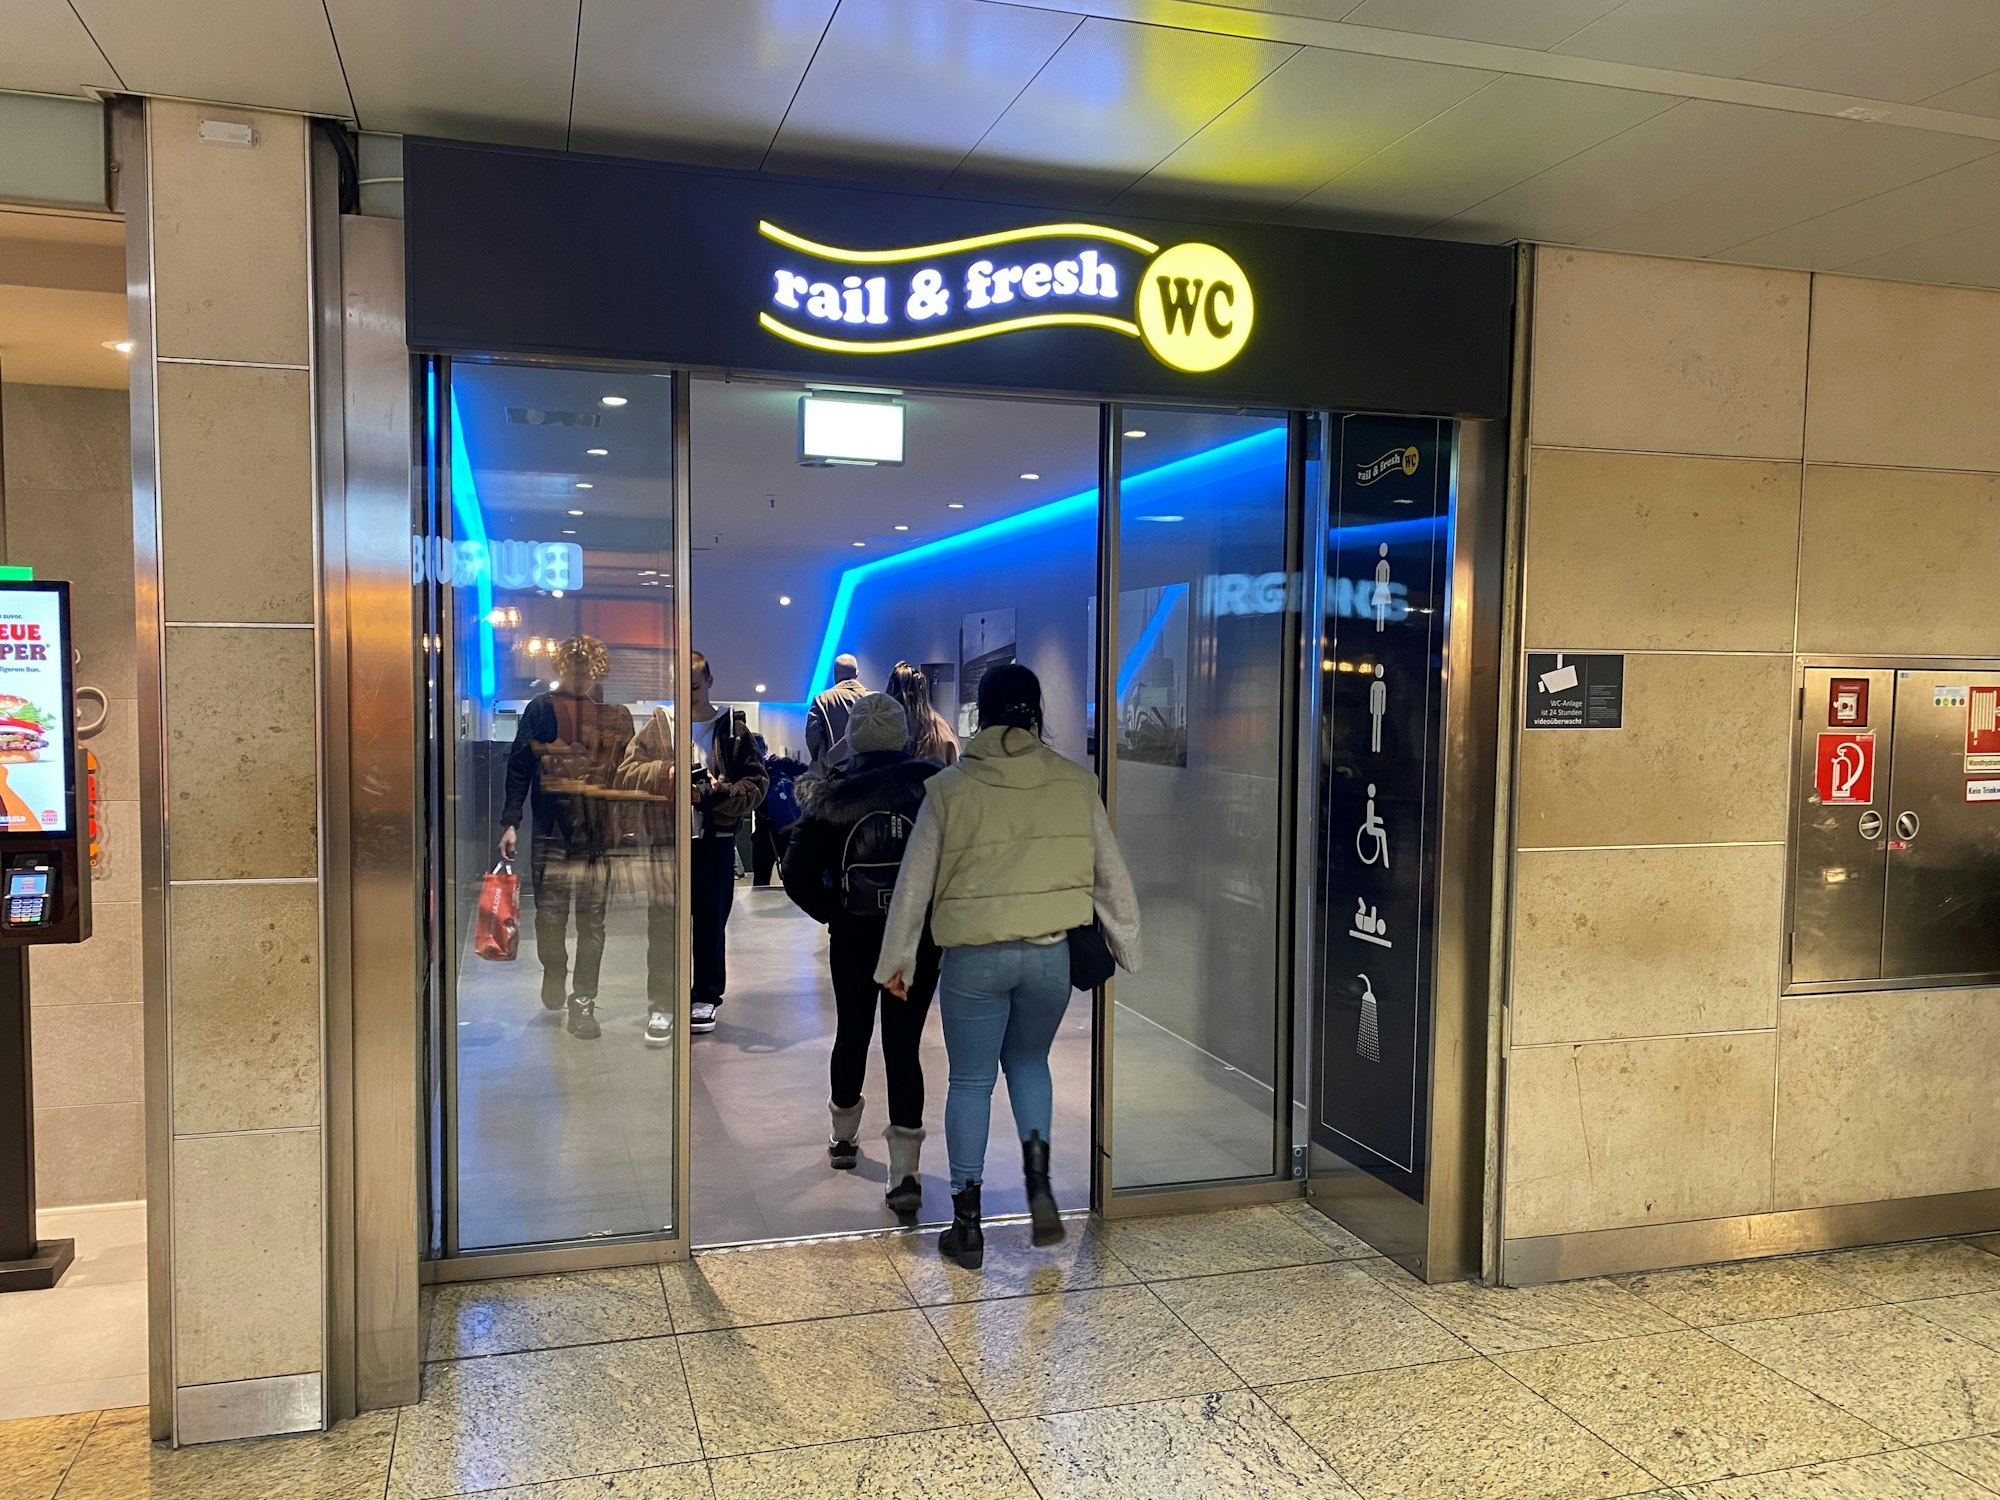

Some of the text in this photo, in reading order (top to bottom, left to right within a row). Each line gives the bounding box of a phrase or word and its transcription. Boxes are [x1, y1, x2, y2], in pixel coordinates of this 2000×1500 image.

[774, 249, 1235, 340] rail & fresh WC
[1358, 454, 1416, 480] rail & fresh WC
[1550, 700, 1582, 708] WC-Anlage
